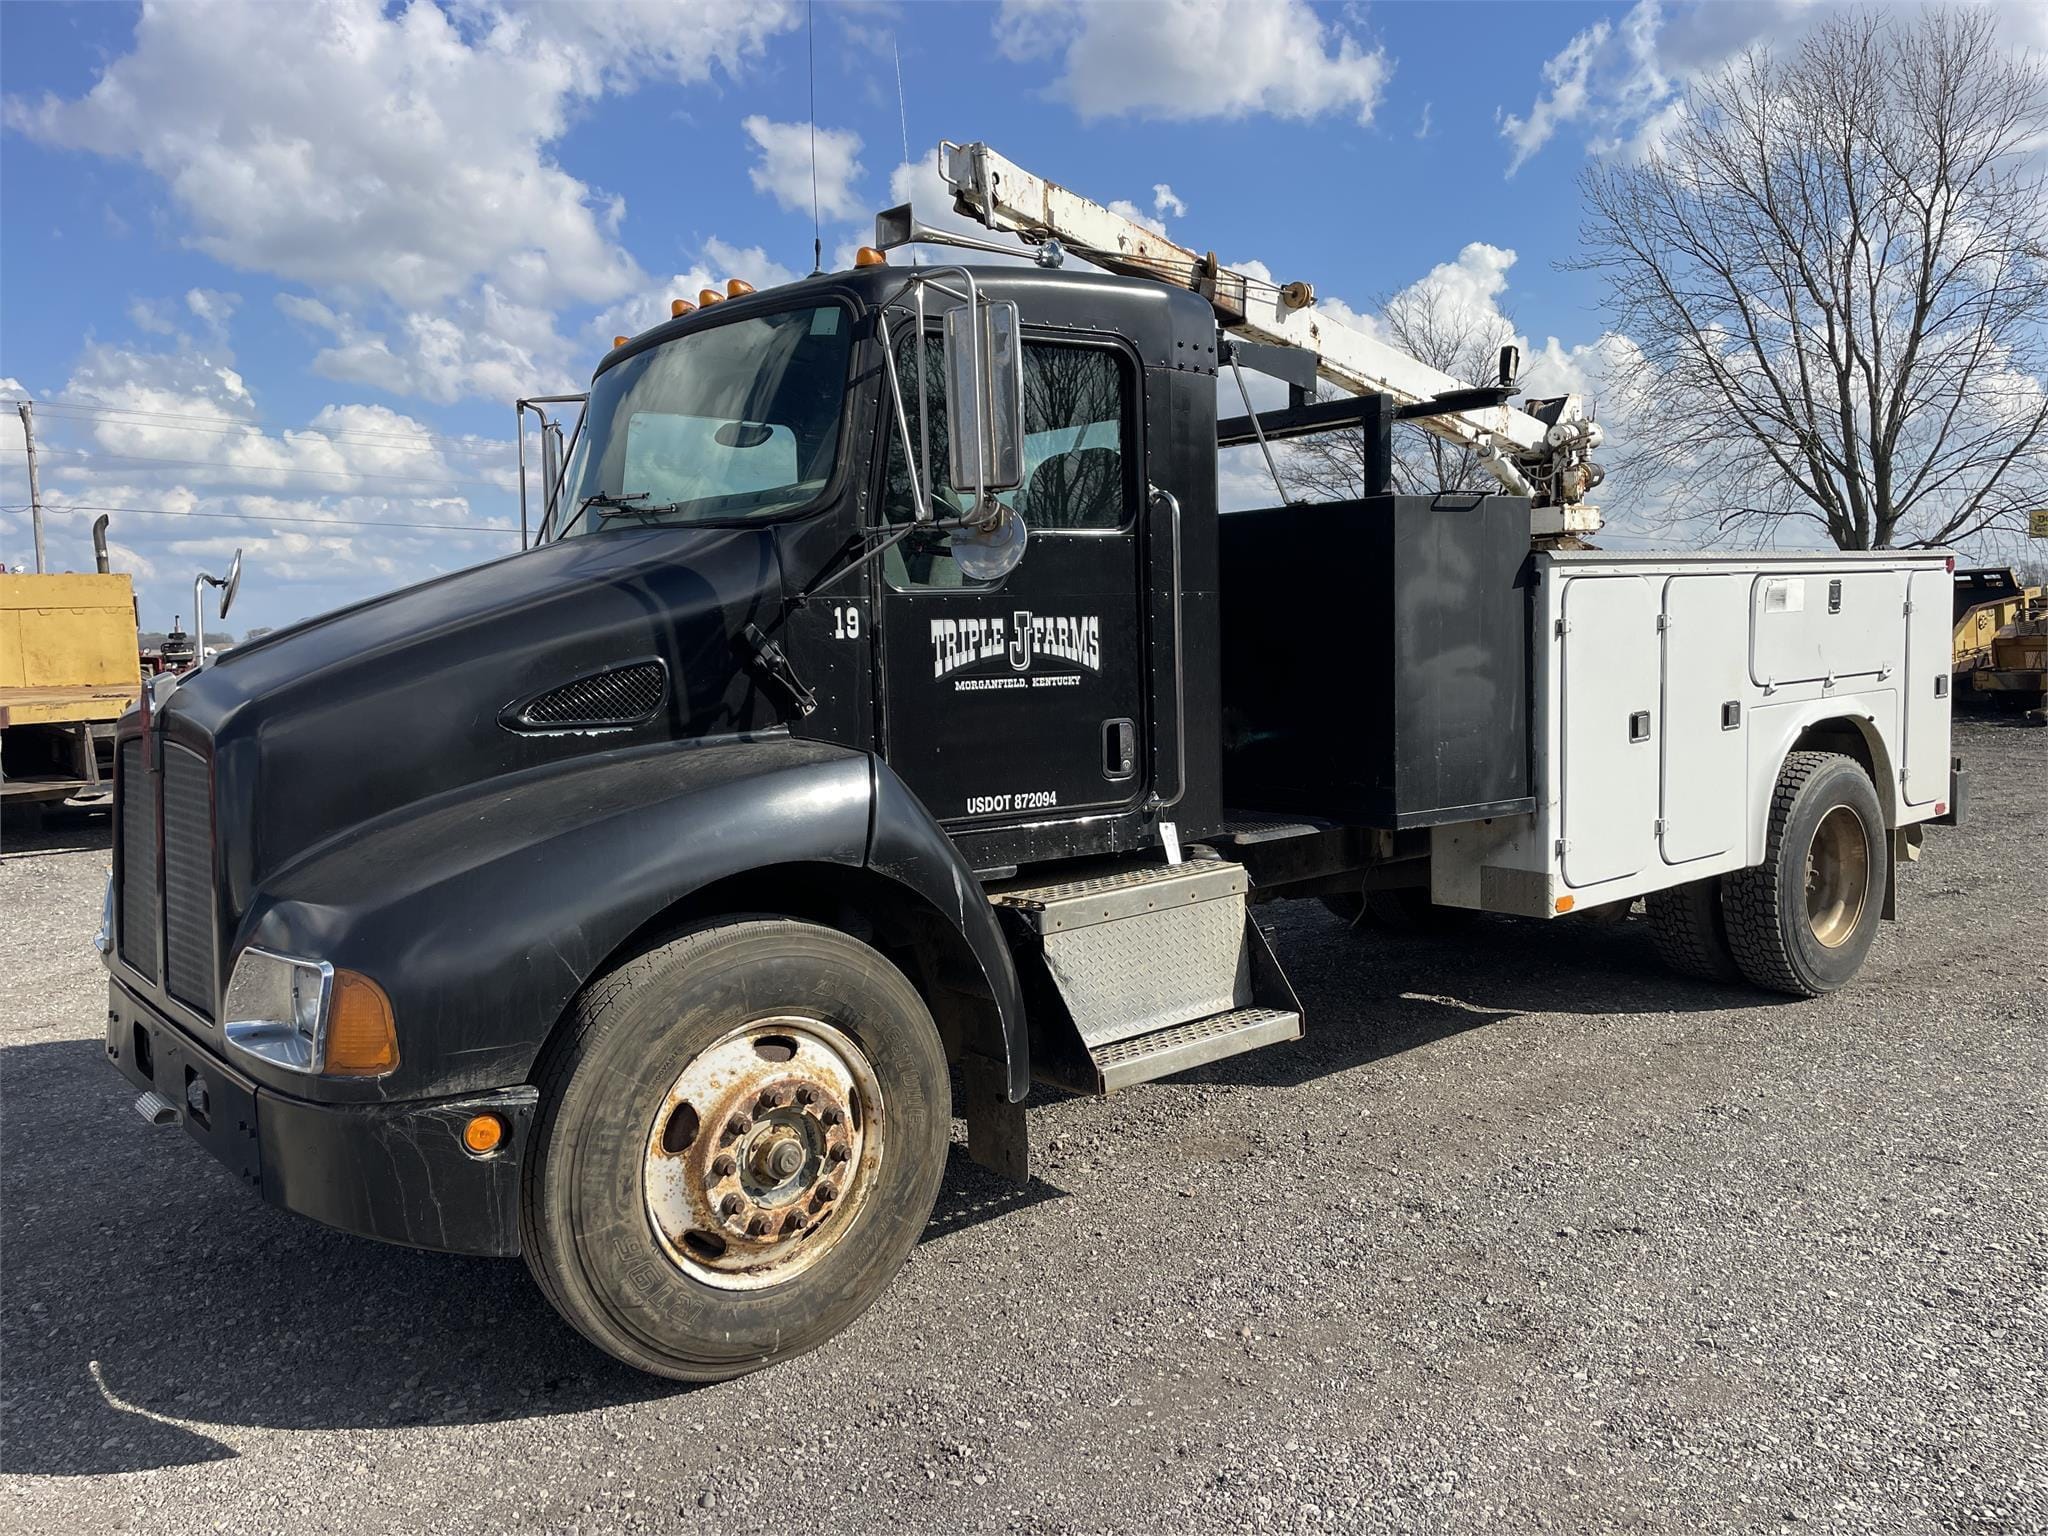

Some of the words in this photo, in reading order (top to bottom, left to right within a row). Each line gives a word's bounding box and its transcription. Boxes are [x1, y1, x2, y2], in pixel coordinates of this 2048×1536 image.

[833, 606, 859, 639] 19
[930, 618, 1005, 679] TRIPLE
[1009, 610, 1033, 672] J
[1032, 616, 1100, 671] FARMS
[954, 678, 1029, 692] MORGANFIELD,
[1032, 675, 1081, 688] KENTUCKY
[966, 794, 1012, 814] USDOT
[1014, 790, 1057, 809] 872094
